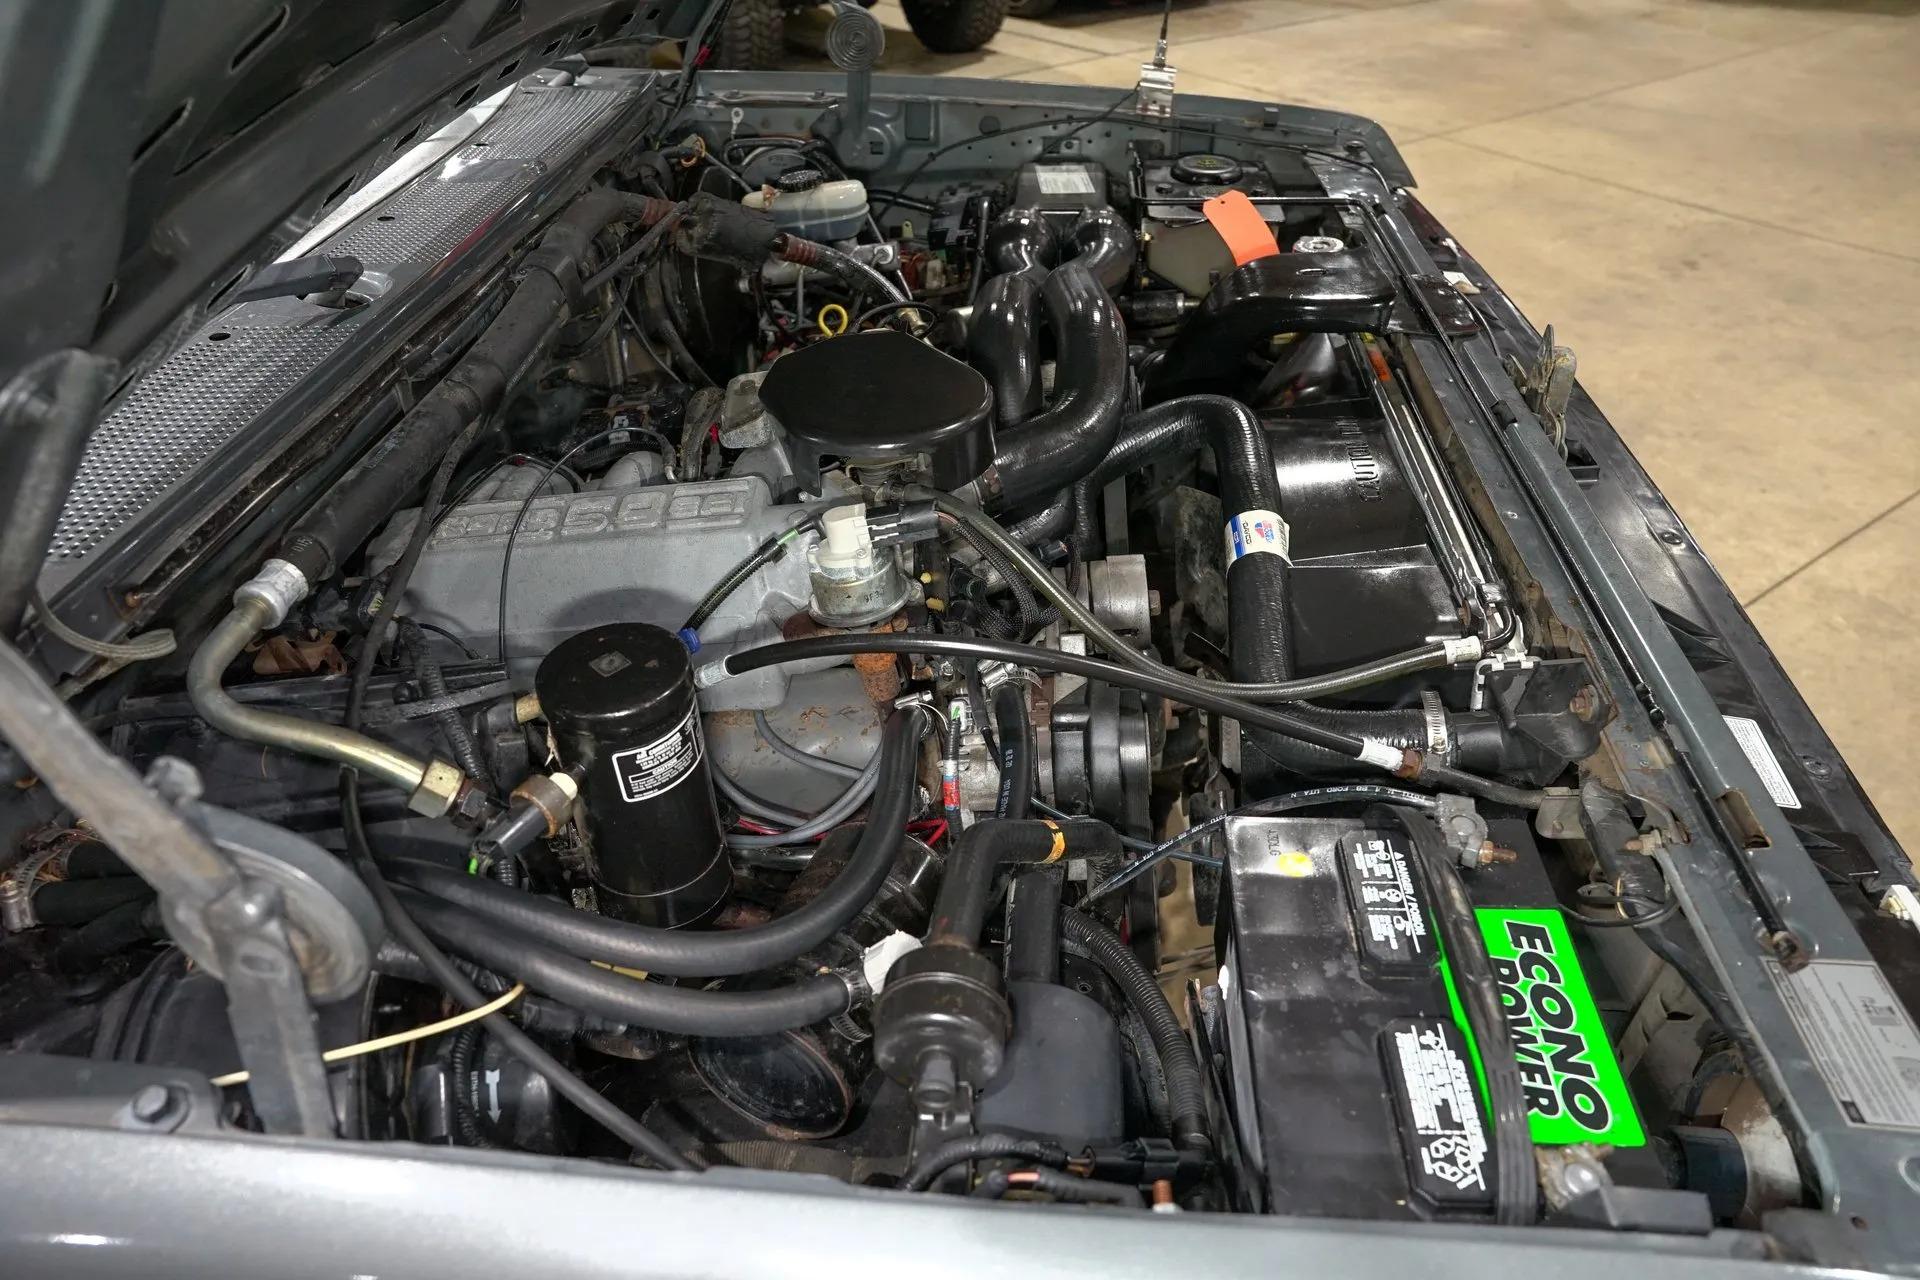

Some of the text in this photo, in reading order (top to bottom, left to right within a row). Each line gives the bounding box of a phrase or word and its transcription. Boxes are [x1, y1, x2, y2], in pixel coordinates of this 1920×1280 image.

[1303, 789, 1320, 797] UTA
[1396, 860, 1415, 895] DANGER
[1408, 902, 1427, 936] POISON
[1490, 955, 1562, 1120] POWER
[1502, 919, 1614, 1136] ECONO
